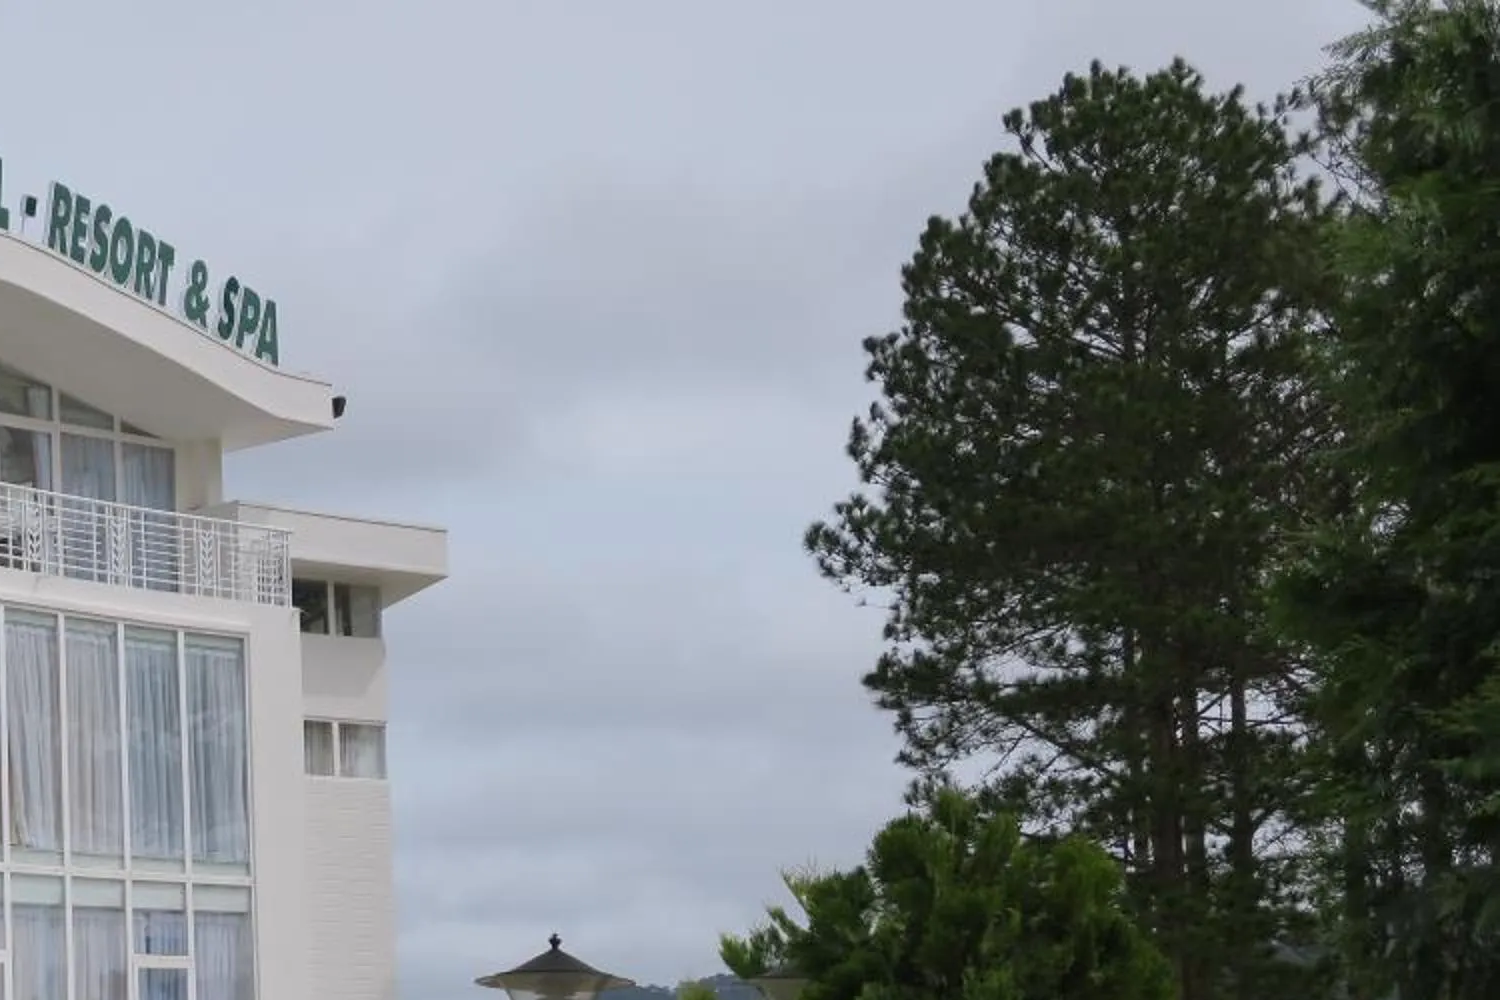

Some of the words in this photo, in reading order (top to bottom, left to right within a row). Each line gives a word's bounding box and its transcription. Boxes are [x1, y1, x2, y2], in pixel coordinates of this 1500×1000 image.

[48, 180, 175, 306] RESORT
[184, 259, 210, 327] &
[217, 275, 279, 366] SPA
